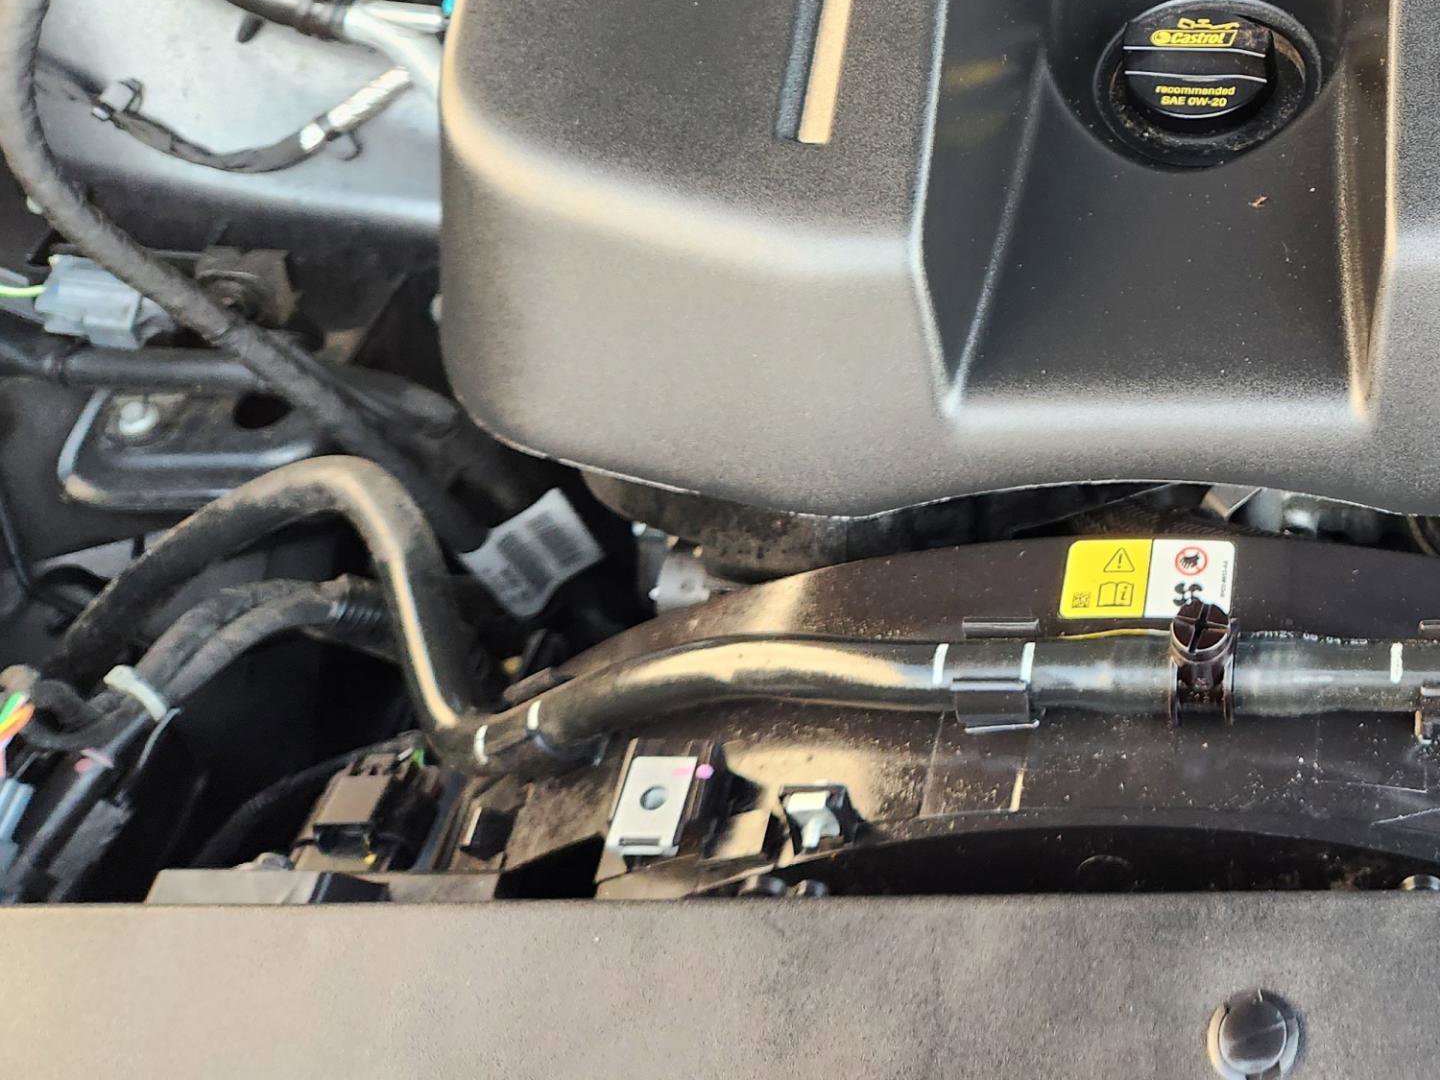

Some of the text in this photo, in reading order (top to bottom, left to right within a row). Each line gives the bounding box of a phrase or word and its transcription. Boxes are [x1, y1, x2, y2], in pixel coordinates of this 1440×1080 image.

[1170, 32, 1225, 44] Castrol
[1155, 85, 1236, 96] recommended
[1160, 95, 1227, 107] SAE 0W-20
